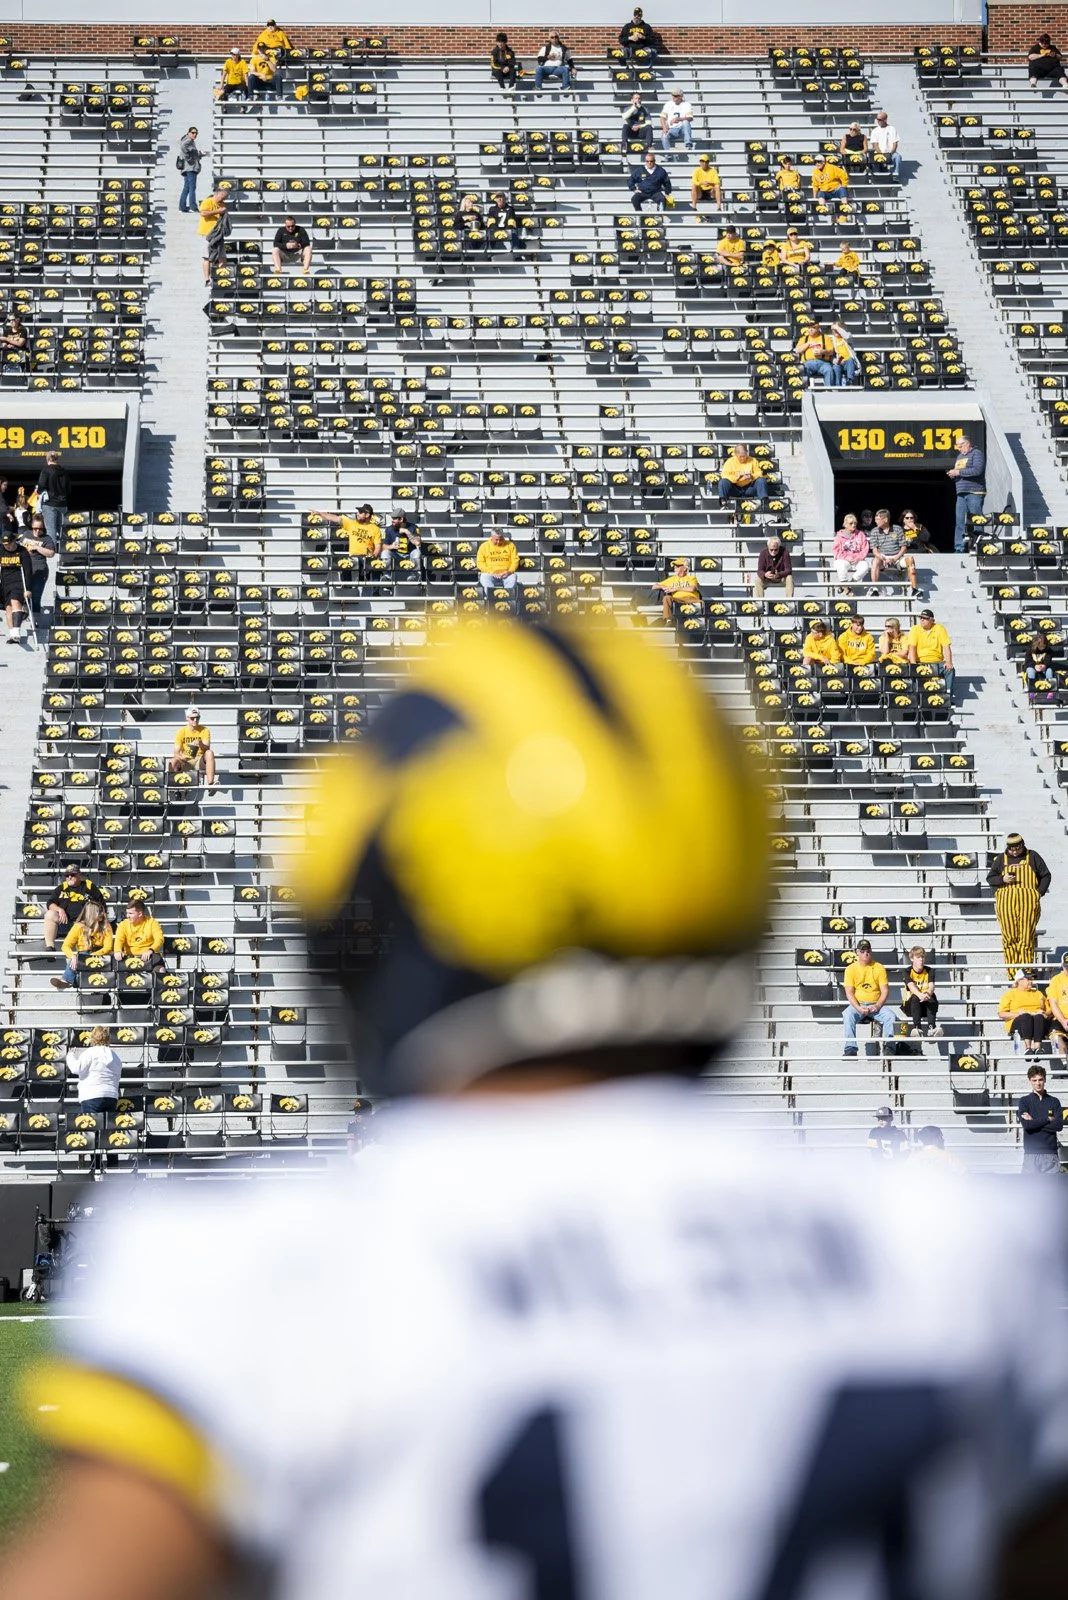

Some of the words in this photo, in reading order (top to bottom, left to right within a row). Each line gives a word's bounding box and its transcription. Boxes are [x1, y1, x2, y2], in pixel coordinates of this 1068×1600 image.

[498, 212, 507, 228] 7
[57, 426, 106, 449] 130
[838, 428, 885, 451] 130
[921, 428, 963, 451] 131
[0, 556, 20, 565] IOWA
[881, 1139, 893, 1159] 5
